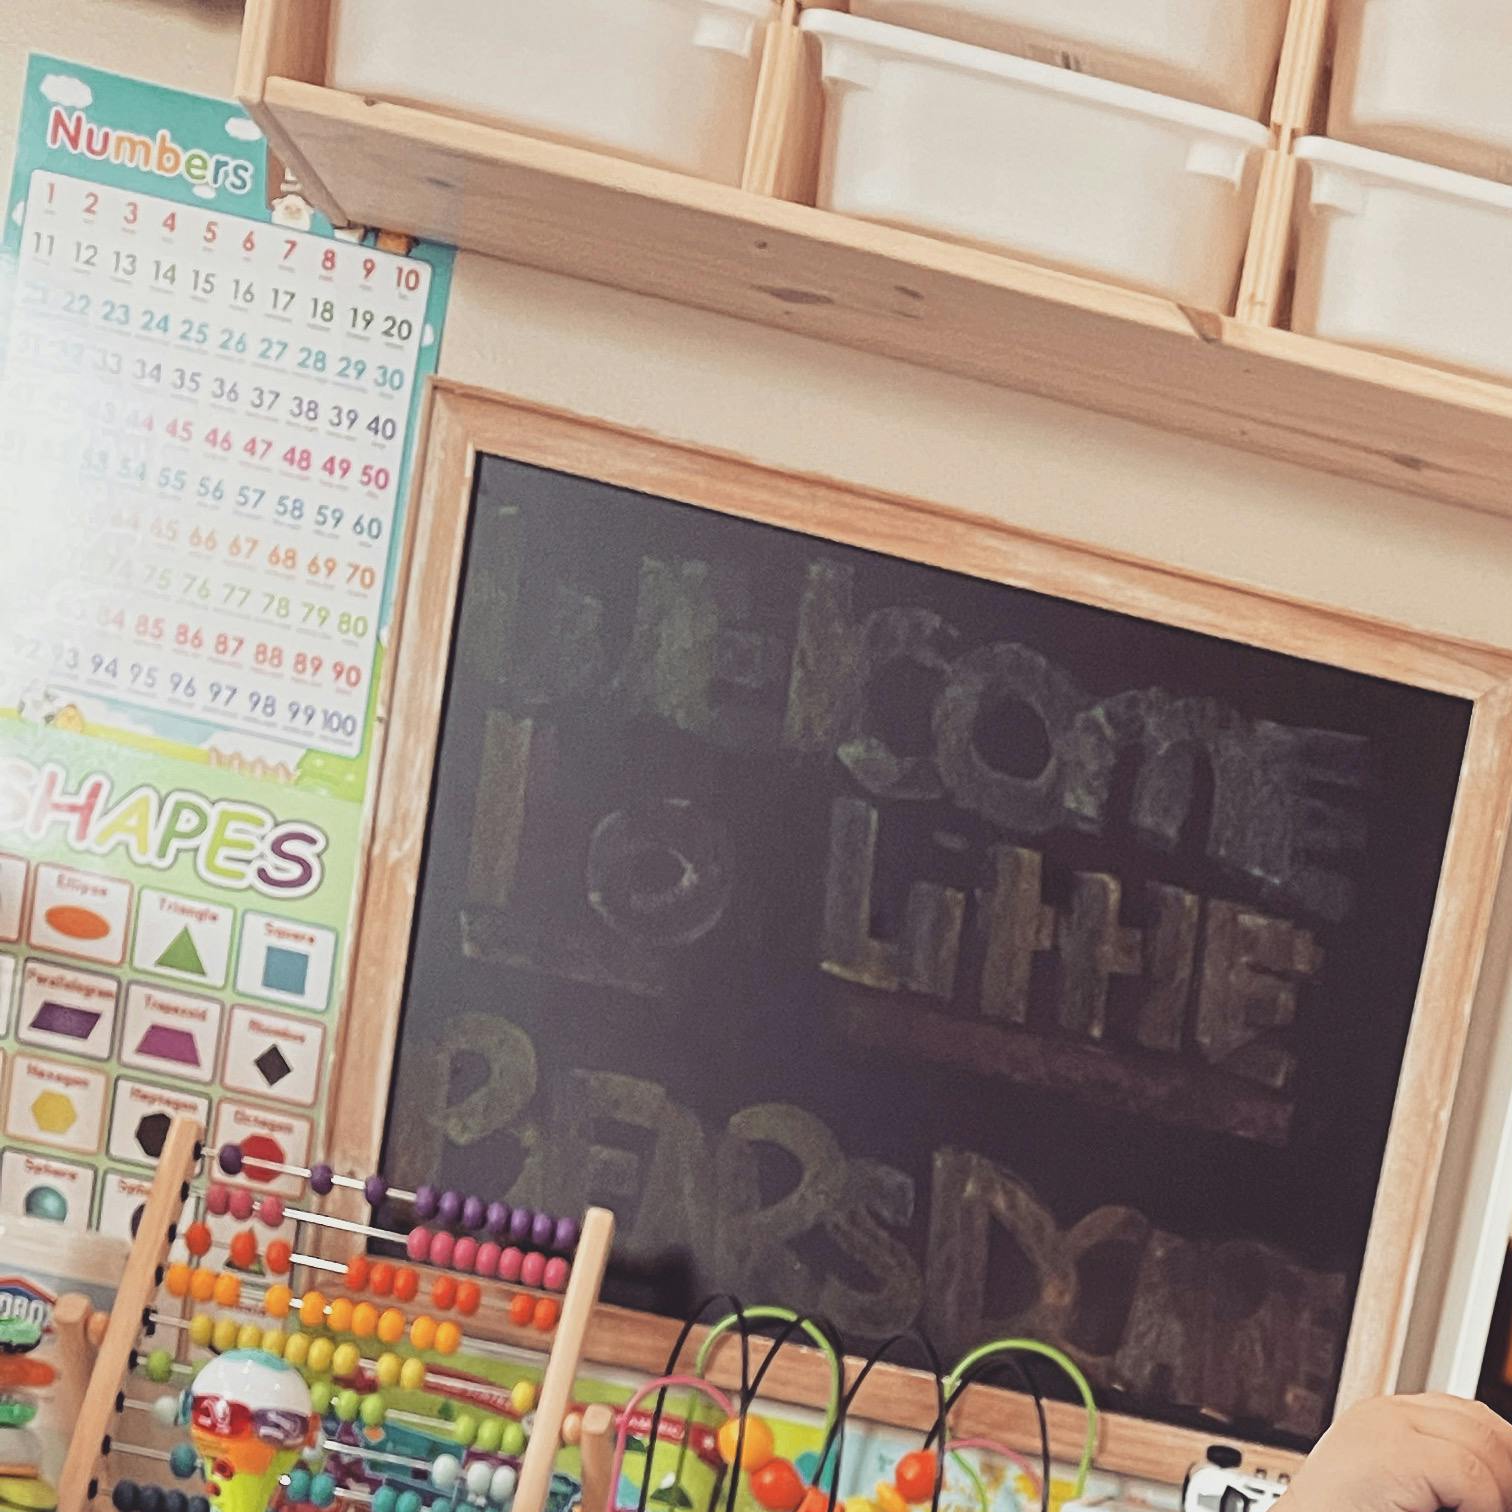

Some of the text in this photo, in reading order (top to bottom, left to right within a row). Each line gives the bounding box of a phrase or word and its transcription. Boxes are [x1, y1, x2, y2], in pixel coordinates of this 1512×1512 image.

[50, 111, 251, 190] Numbers
[83, 191, 99, 216] 2
[123, 201, 139, 225] 3
[162, 211, 177, 233] 4
[202, 220, 218, 244] 5
[242, 230, 256, 252] 6
[283, 239, 297, 261] 7
[321, 248, 336, 272] 8
[362, 258, 376, 280] 9
[396, 266, 424, 292] 10
[34, 231, 413, 341] 11 12 13 14 15 16 17 18 19 20
[61, 290, 92, 316] 22
[101, 299, 131, 326] 23
[140, 309, 170, 335] 24
[178, 318, 209, 345] 25
[218, 327, 247, 354] 26
[258, 337, 289, 362] 27
[296, 346, 328, 373] 28
[335, 356, 367, 381] 29
[373, 364, 405, 390] 30
[135, 358, 162, 384] 34
[171, 367, 203, 393] 35
[211, 376, 240, 403] 36
[250, 386, 281, 411] 37
[289, 395, 320, 422] 38
[328, 405, 359, 430] 39
[365, 415, 397, 441] 40
[165, 418, 193, 443] 45
[204, 427, 233, 452] 46
[242, 436, 273, 460] 47
[282, 446, 312, 472] 48
[321, 455, 352, 479] 49
[359, 464, 390, 491] 50
[157, 466, 188, 492] 55
[196, 476, 225, 502] 56
[235, 485, 267, 509] 57
[275, 495, 305, 521] 58
[314, 504, 345, 529] 59
[352, 514, 382, 540] 60
[150, 515, 180, 543] 65
[188, 525, 218, 552] 66
[227, 534, 260, 560] 67
[267, 544, 298, 570] 68
[307, 555, 338, 579] 69
[346, 562, 376, 590] 70
[144, 564, 174, 591] 75
[182, 573, 212, 601] 76
[222, 583, 252, 609] 77
[261, 592, 291, 619] 78
[301, 601, 331, 628] 79
[337, 611, 369, 638] 80
[134, 614, 166, 641] 85
[175, 623, 204, 650] 86
[214, 632, 245, 657] 87
[253, 642, 284, 669] 88
[293, 652, 324, 678] 89
[331, 661, 362, 689] 90
[91, 653, 119, 679] 94
[129, 662, 159, 689] 95
[169, 672, 197, 698] 96
[209, 682, 238, 707] 97
[248, 691, 277, 718] 98
[288, 701, 316, 726] 99
[321, 709, 357, 736] 100
[0, 760, 317, 889] SHAPES
[159, 896, 219, 922] Triangle
